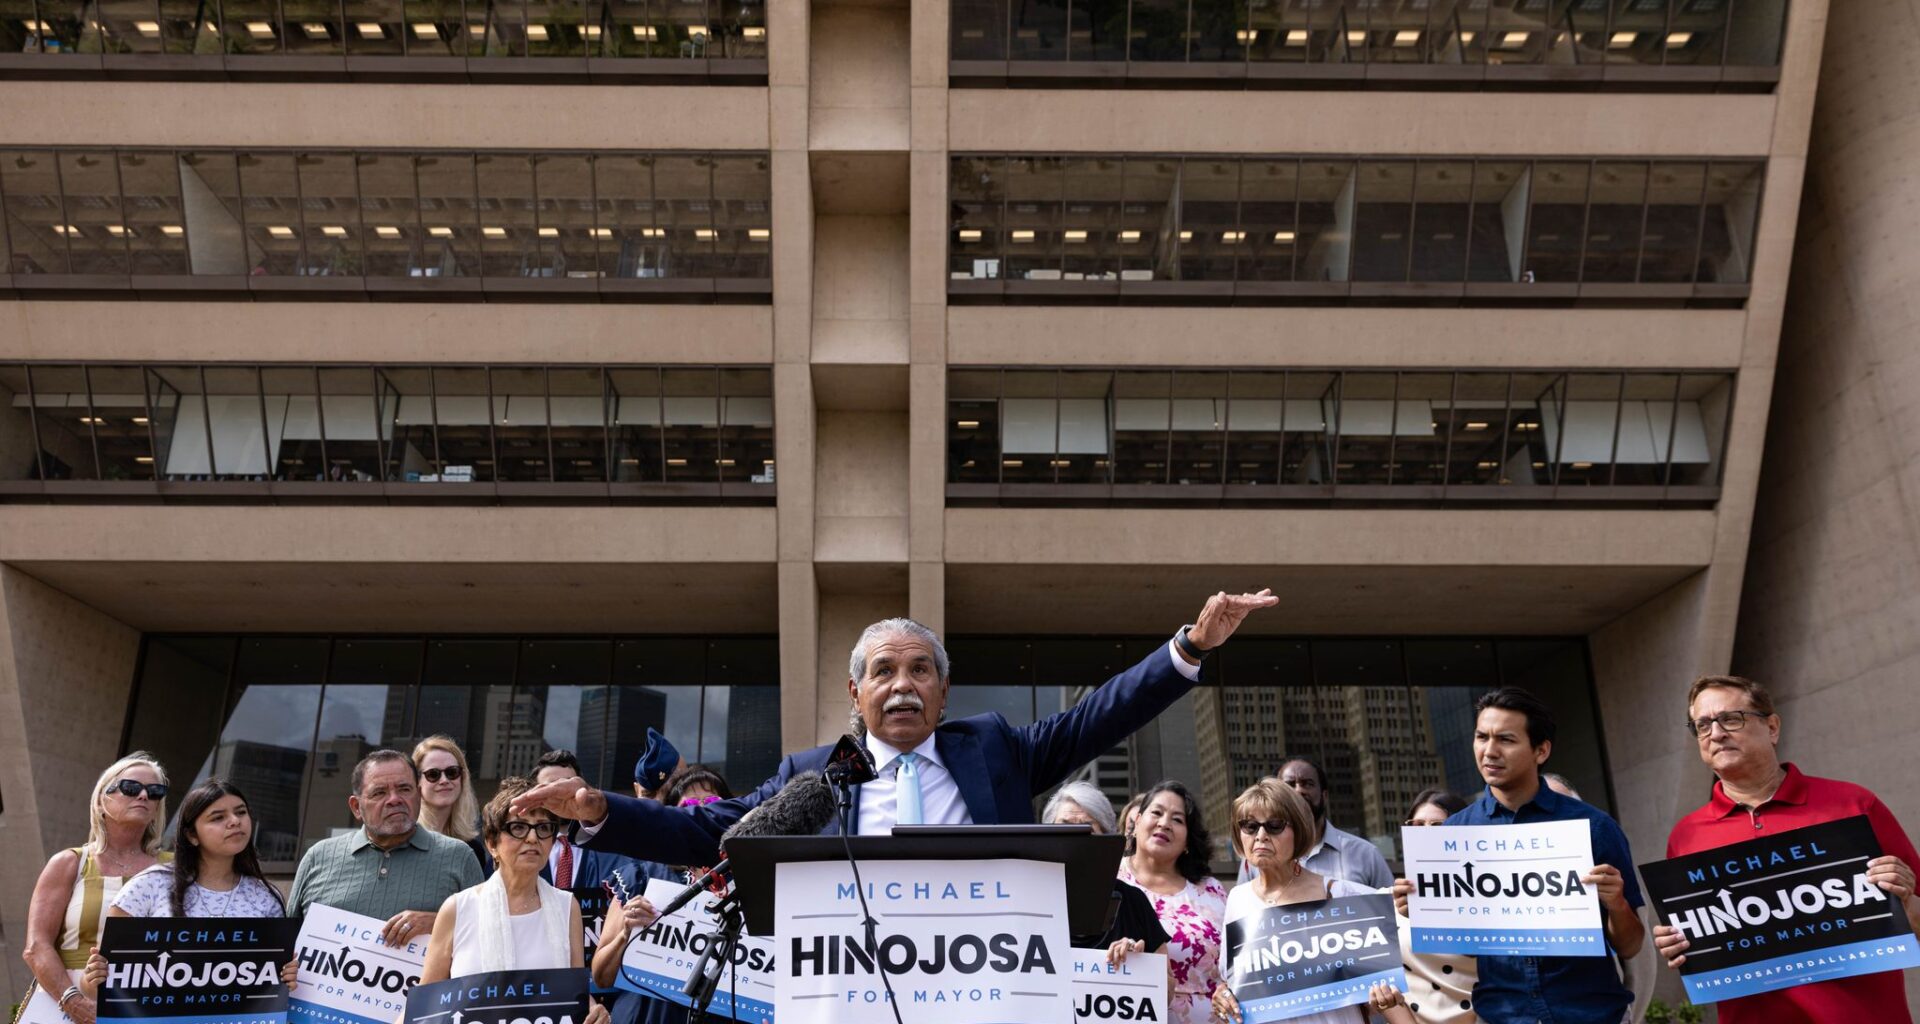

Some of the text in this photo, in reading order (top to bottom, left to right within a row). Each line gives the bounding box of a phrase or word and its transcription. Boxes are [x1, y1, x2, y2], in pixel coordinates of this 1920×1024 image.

[1444, 837, 1555, 851] MICHAEL
[1687, 842, 1826, 884] MICHAEL
[837, 881, 1010, 900] MICHAEL
[1417, 868, 1587, 898] HINOJOSA
[1458, 906, 1556, 915] FOR MAYOR
[1668, 873, 1887, 939] HINOJOSA
[144, 931, 258, 943] MICHAEL
[1422, 935, 1595, 943] HINOJOSAFORDALLAS.COM
[1727, 918, 1848, 951] FOR MAYOR
[666, 957, 693, 969] FOR
[791, 930, 1056, 977] HINOJOSA
[105, 959, 280, 989] HINOJOSA
[1267, 957, 1355, 985] FOR MAYOR
[1696, 945, 1906, 989] HINOJOSAFORDALLAS.COM
[142, 994, 241, 1005] FOR MAYOR
[317, 984, 402, 1012] FOR MAYOR
[440, 984, 550, 1005] MICHAEL
[847, 988, 1001, 1003] FOR MAYOR
